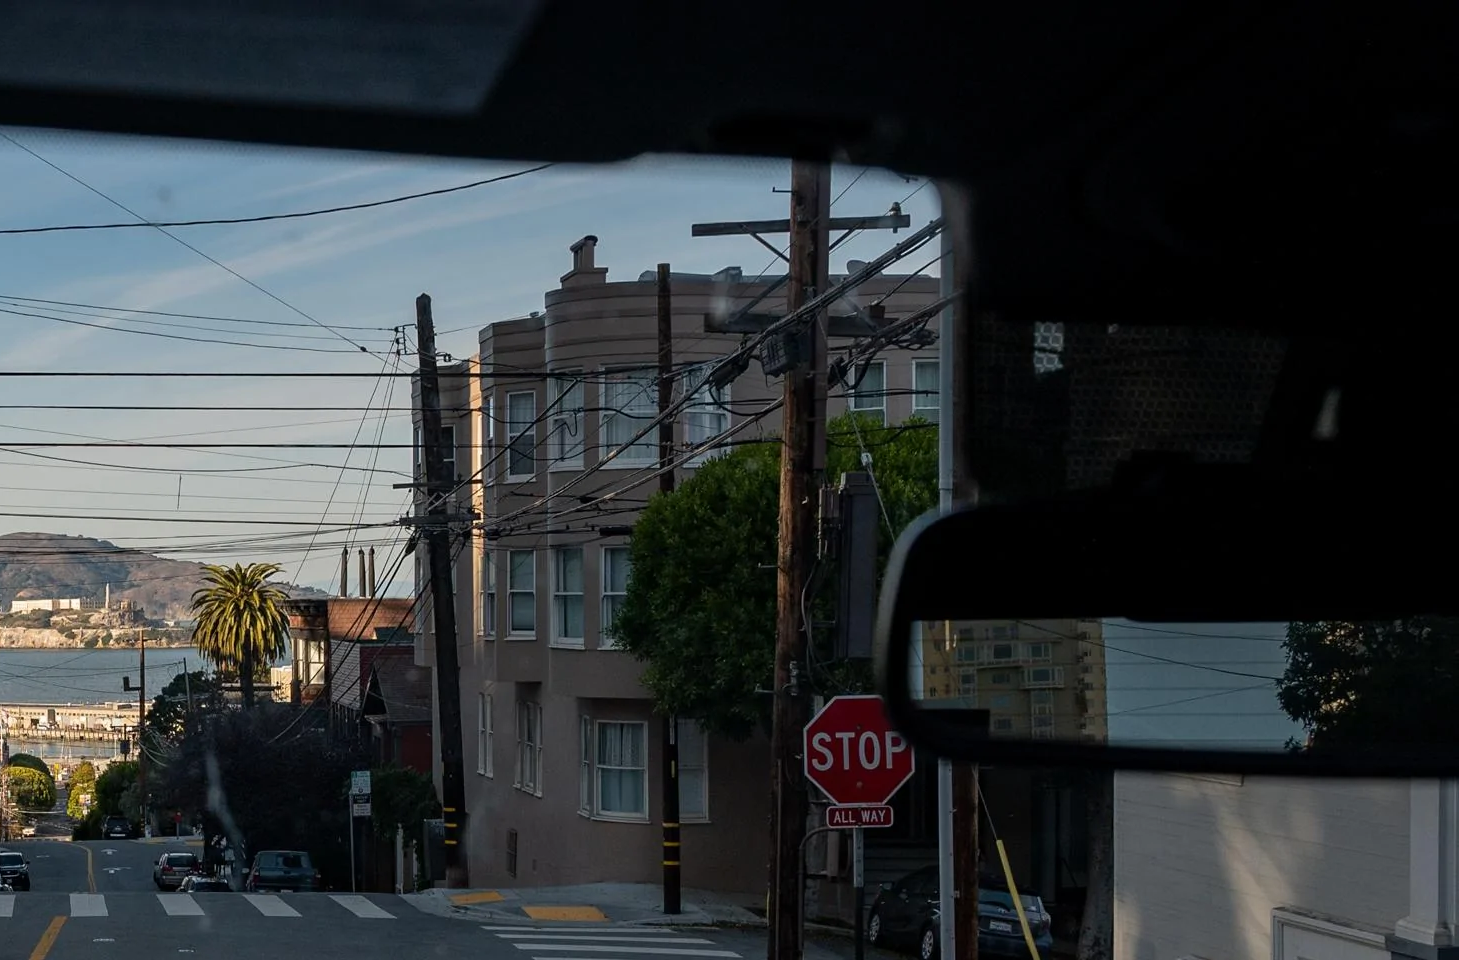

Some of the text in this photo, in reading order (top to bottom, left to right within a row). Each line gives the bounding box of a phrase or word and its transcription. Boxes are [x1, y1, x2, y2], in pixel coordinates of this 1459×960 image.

[811, 730, 908, 772] STOP
[833, 809, 886, 824] ALL WAY
